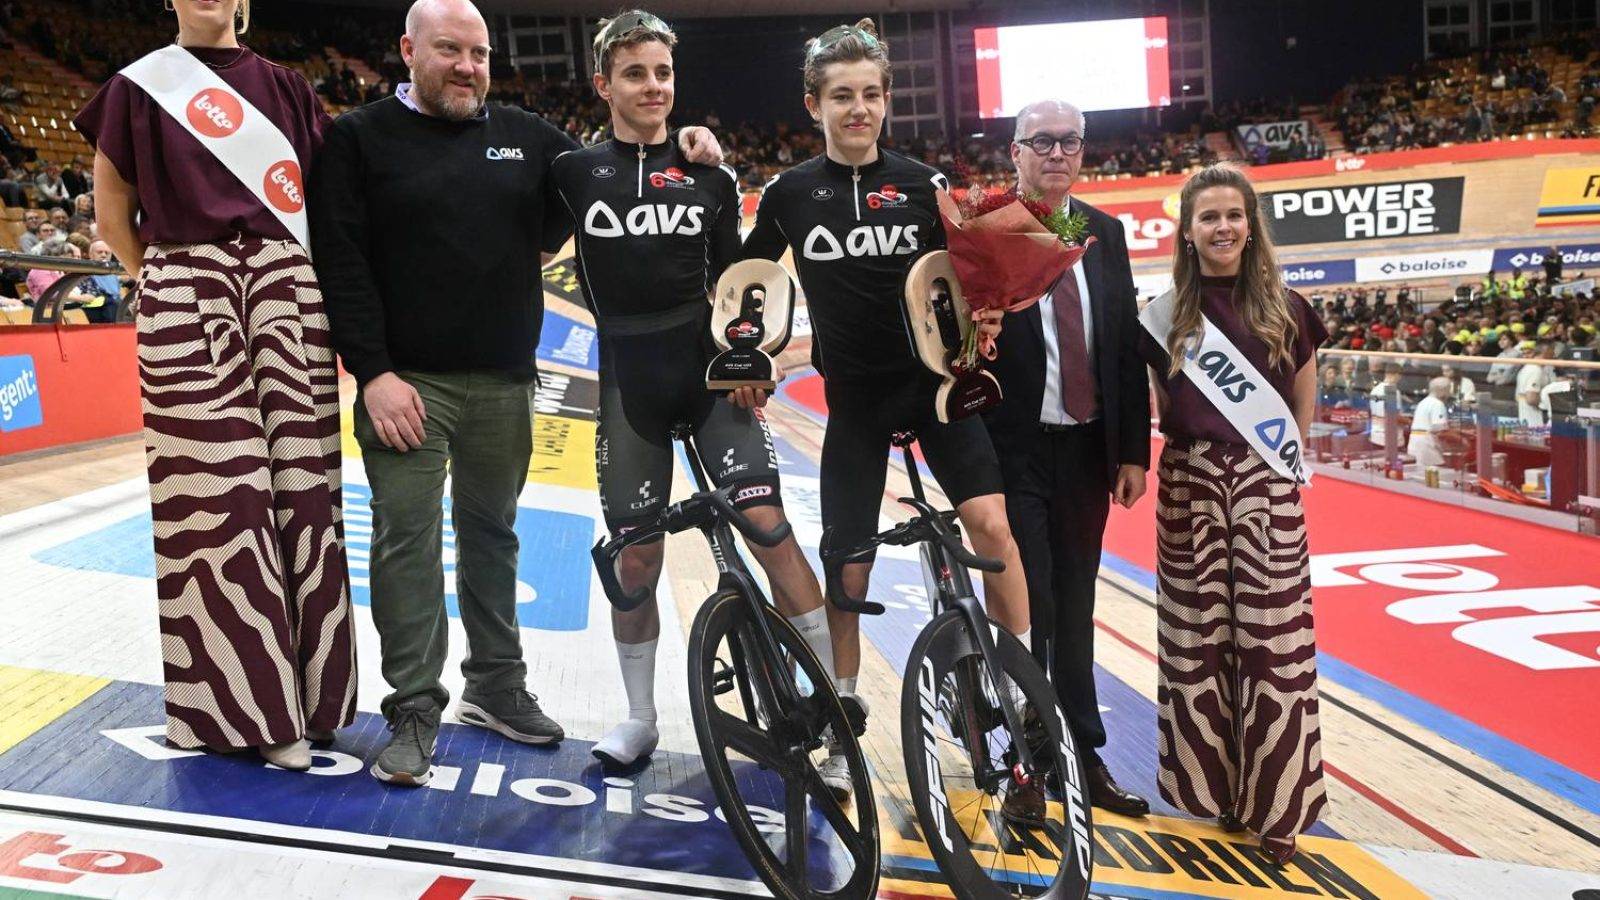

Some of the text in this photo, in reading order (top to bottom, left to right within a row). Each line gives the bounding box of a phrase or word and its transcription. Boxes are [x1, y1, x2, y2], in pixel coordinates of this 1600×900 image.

[499, 147, 524, 159] avs
[1272, 182, 1434, 220] POWER
[626, 203, 704, 236] avs
[1345, 207, 1437, 239] ADE
[846, 224, 919, 257] avs
[1399, 258, 1468, 274] baloise
[1198, 350, 1257, 403] avs
[601, 438, 609, 465] VINI
[719, 463, 749, 478] CUBE
[738, 486, 769, 499] ANTY
